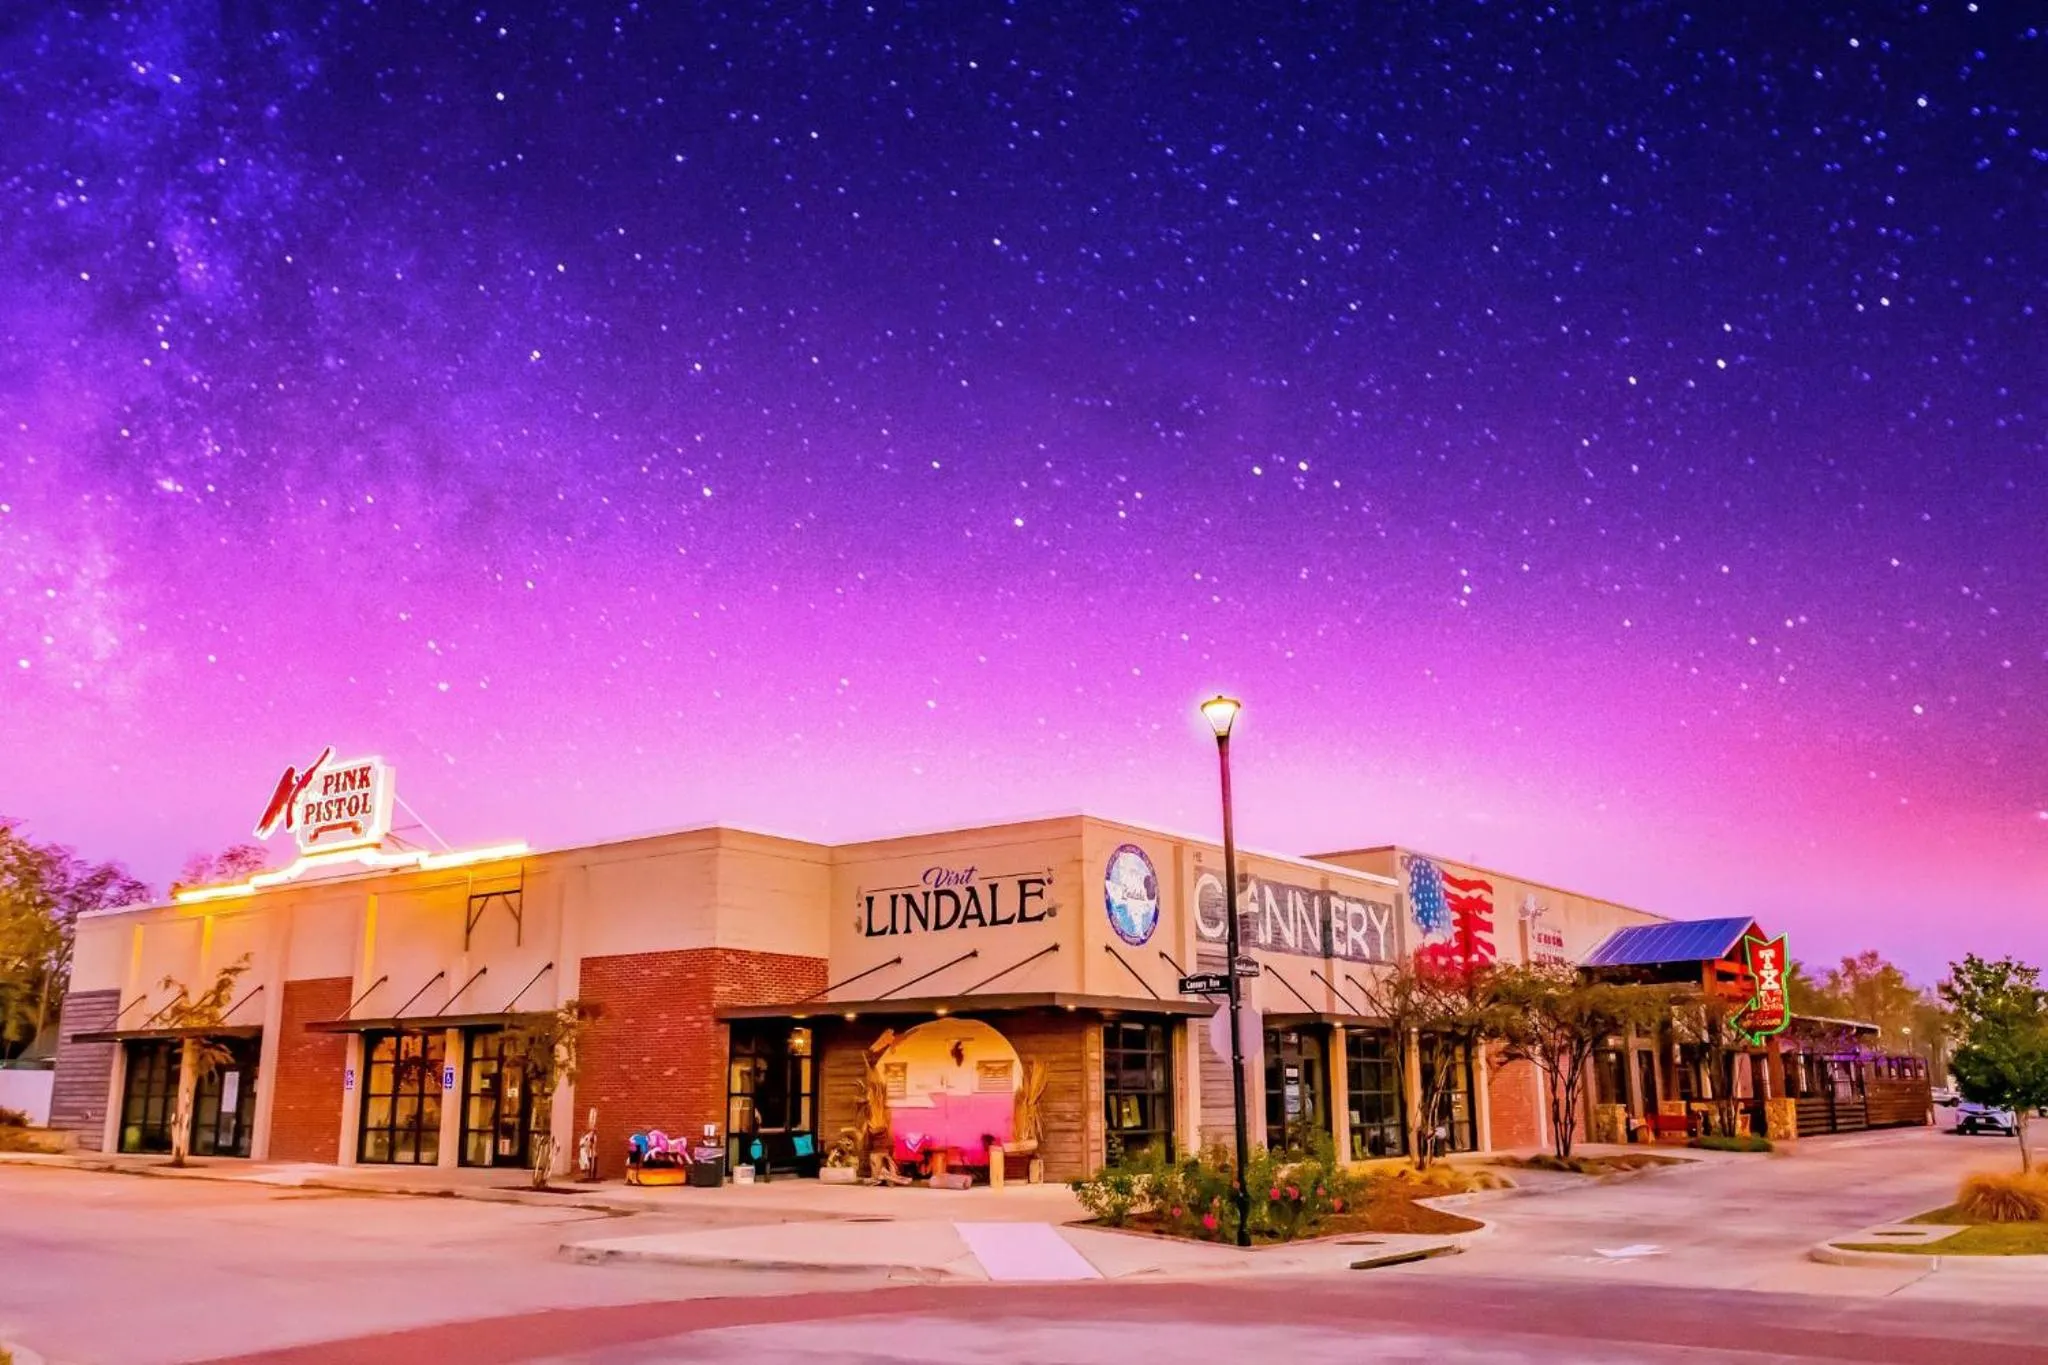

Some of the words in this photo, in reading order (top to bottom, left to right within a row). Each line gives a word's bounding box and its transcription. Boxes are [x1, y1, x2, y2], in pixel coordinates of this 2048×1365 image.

[322, 766, 371, 795] PINK
[303, 793, 371, 825] PISTOL
[922, 866, 978, 889] Visit
[865, 879, 1047, 937] LINDALE
[1193, 872, 1390, 961] CANNERY
